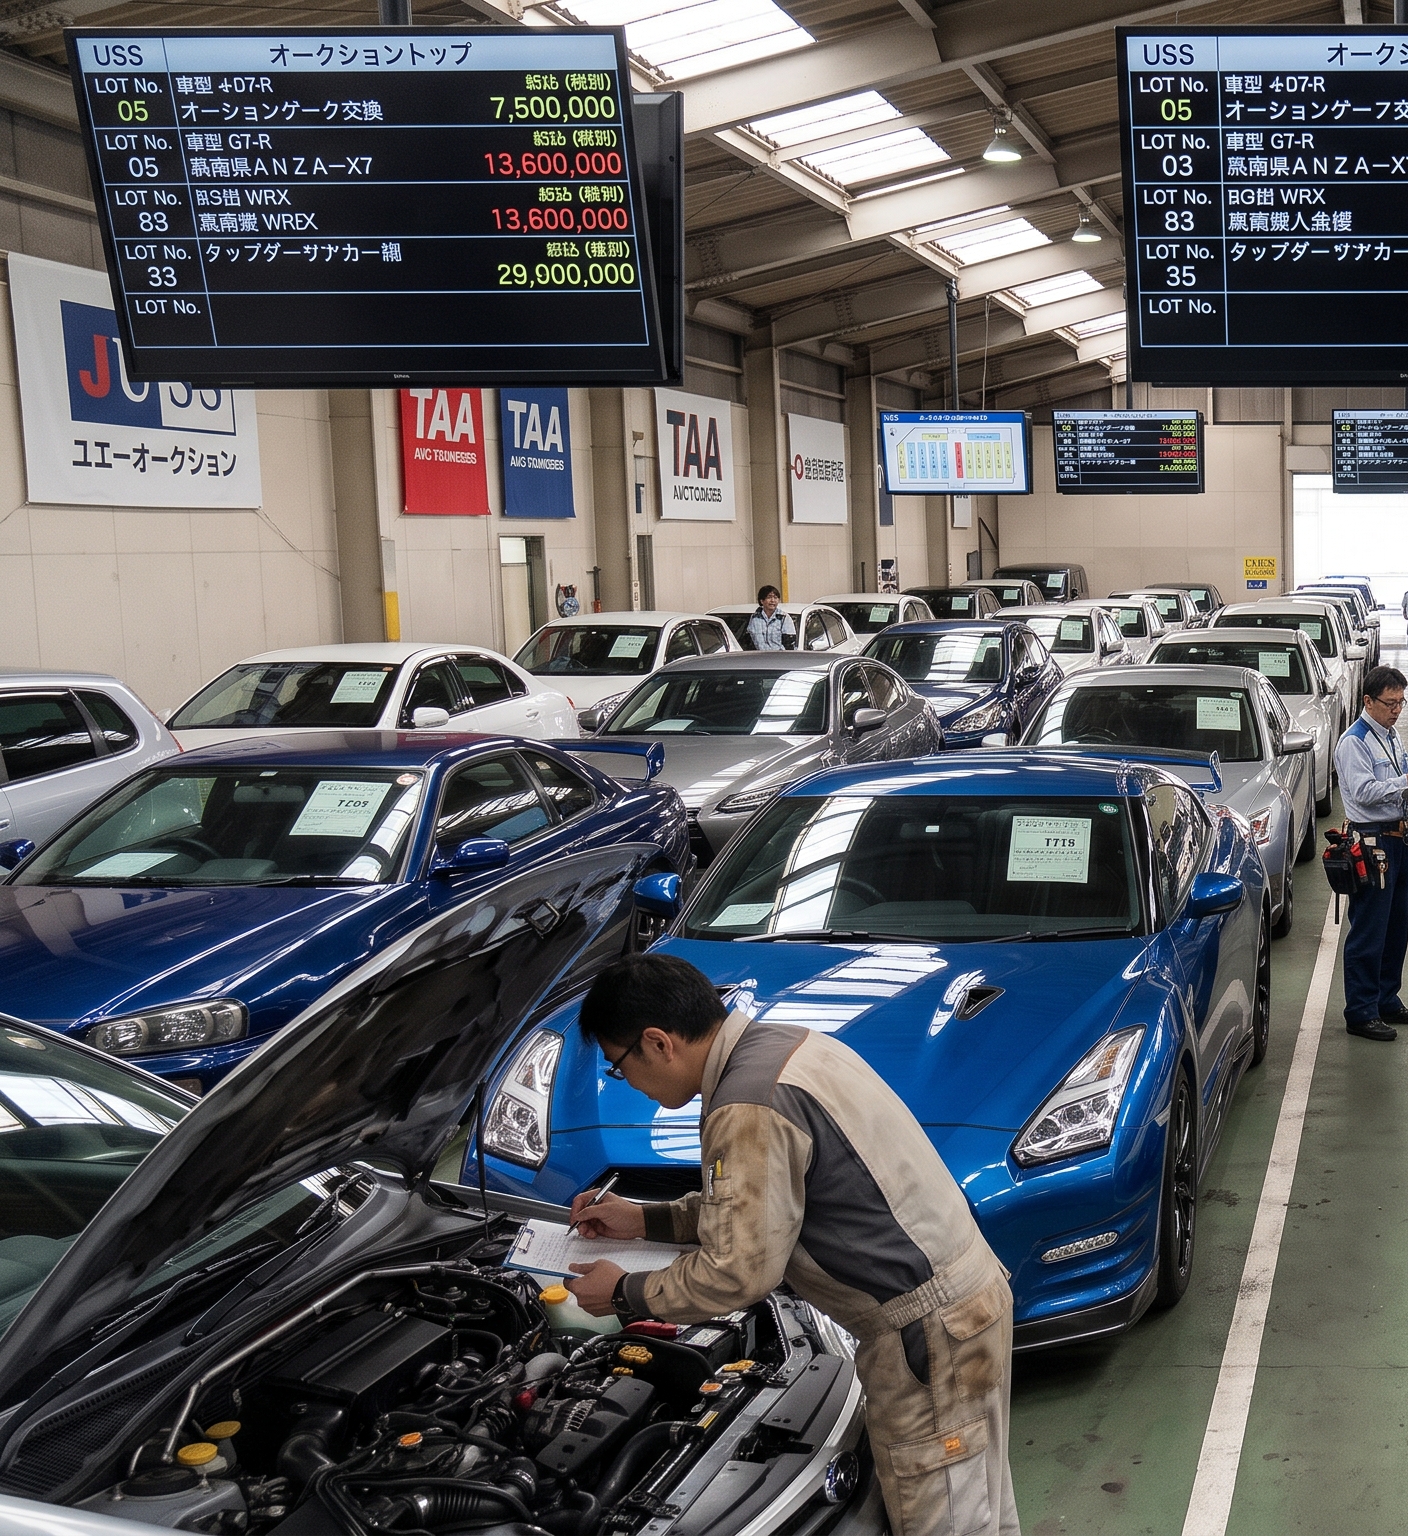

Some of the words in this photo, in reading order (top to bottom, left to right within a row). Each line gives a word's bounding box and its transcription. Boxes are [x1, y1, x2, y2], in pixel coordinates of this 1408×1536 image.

[93, 45, 144, 67] USS
[270, 42, 473, 67] オークショントップ
[1143, 44, 1195, 66] USS
[95, 78, 128, 94] LOT
[134, 78, 163, 94] No.
[1139, 77, 1175, 93] LOT
[1180, 77, 1209, 93] No.
[118, 100, 149, 122] 05
[490, 96, 616, 124] 7,500,000
[1161, 99, 1193, 121] 05
[104, 134, 139, 151] LOT
[144, 134, 173, 152] No.
[1140, 134, 1176, 150] LOT
[1181, 134, 1211, 150] No.
[128, 156, 159, 179] 05
[484, 152, 622, 179] 13,600,000
[1162, 155, 1194, 177] 03
[115, 190, 149, 206] LOT
[153, 190, 182, 206] No.
[245, 189, 292, 206] WRX
[1143, 189, 1178, 205] LOT
[1183, 189, 1213, 205] No.
[1279, 188, 1327, 206] WRX
[491, 208, 629, 234] 13,600,000
[1164, 210, 1196, 232] 83
[125, 245, 158, 261] LOT
[163, 245, 192, 261] No.
[1146, 244, 1180, 260] LOT
[1186, 244, 1216, 260] No.
[147, 267, 178, 288] 33
[497, 263, 636, 289] 29,900,000
[1166, 266, 1197, 287] 35
[135, 300, 168, 315] LOT
[173, 300, 202, 315] No.
[1149, 299, 1183, 315] LOT
[1188, 299, 1218, 315] No.
[410, 388, 476, 444] TAA
[508, 400, 564, 453] TAA
[666, 409, 723, 481] TAA
[72, 439, 237, 477] ユエーオークション
